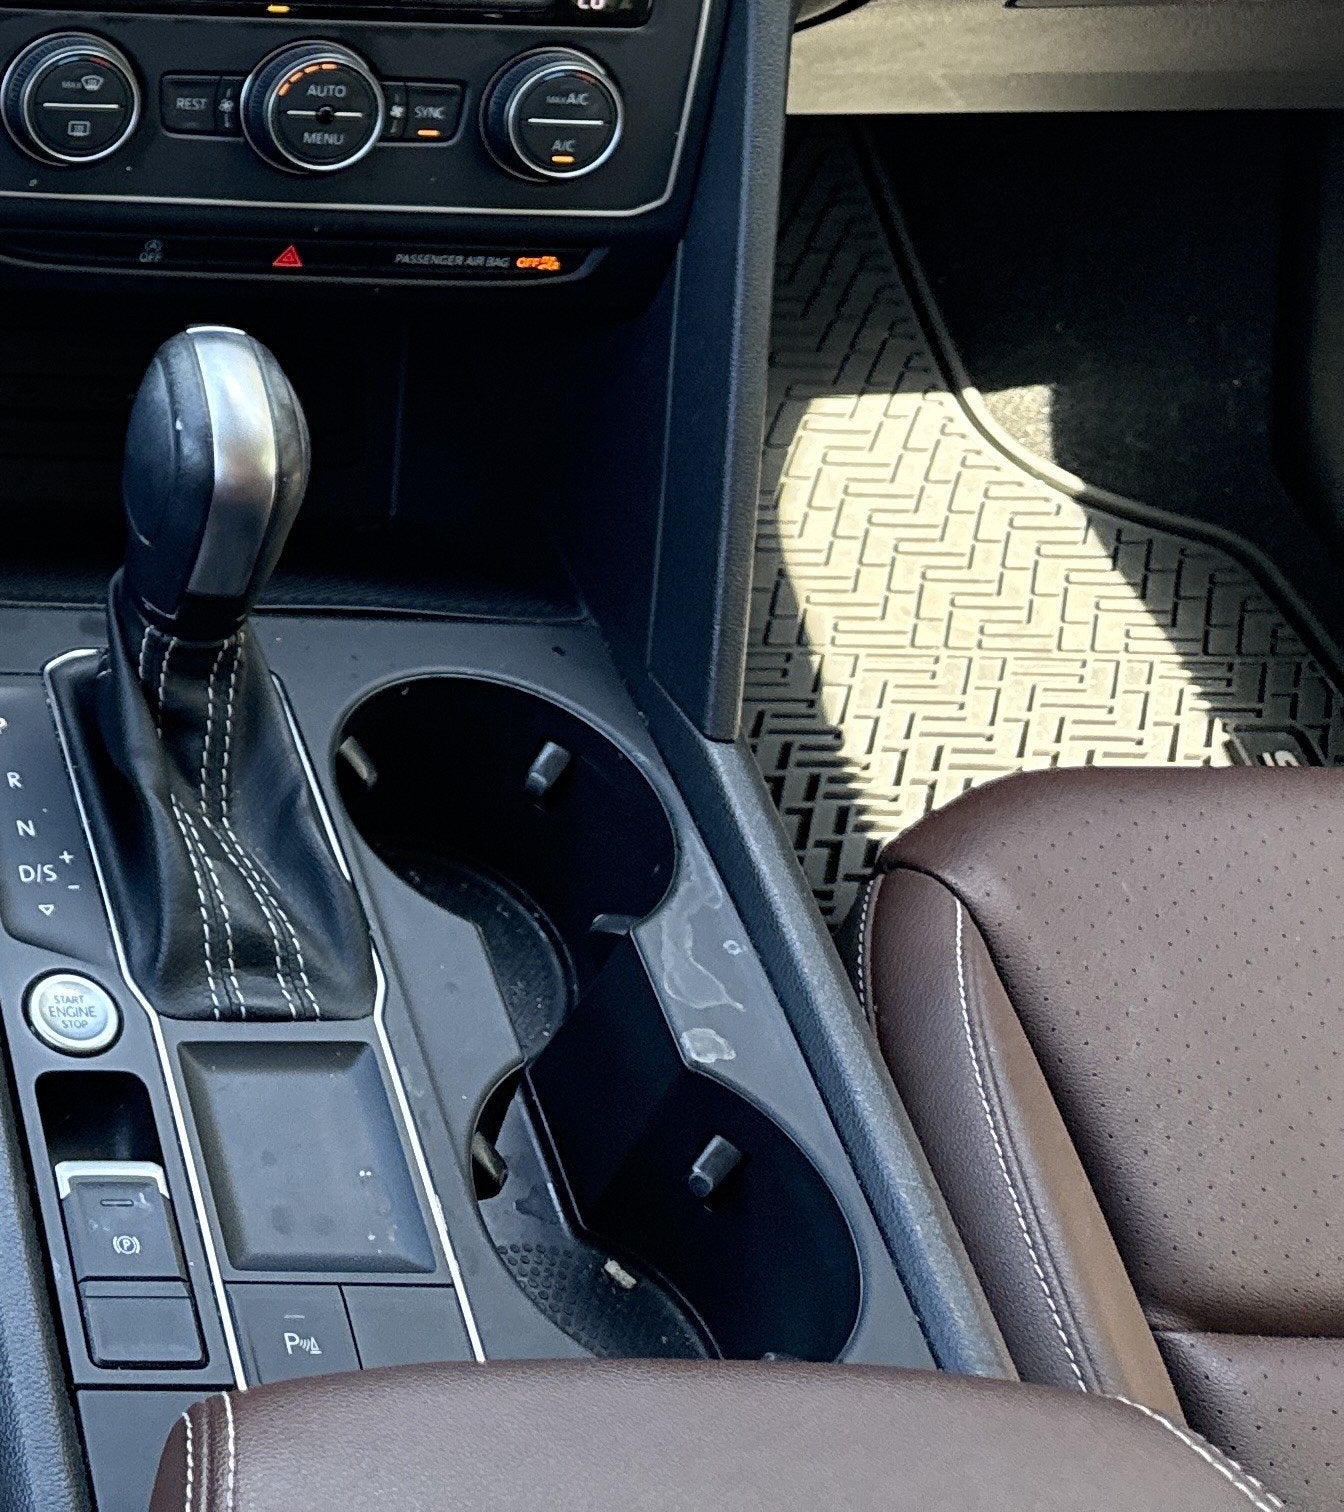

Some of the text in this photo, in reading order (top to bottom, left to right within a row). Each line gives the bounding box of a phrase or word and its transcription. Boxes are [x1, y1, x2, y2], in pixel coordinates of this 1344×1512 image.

[307, 84, 347, 98] AUTO
[176, 97, 207, 111] REST
[415, 106, 445, 120] SYNC
[303, 132, 345, 146] MENU
[551, 139, 577, 153] A/C
[394, 253, 463, 266] PASSENGER
[7, 772, 23, 788] R
[16, 820, 36, 837] N
[18, 863, 57, 883] D/S
[54, 995, 84, 1004] START
[48, 1005, 97, 1018] ENGINE
[62, 1019, 88, 1029] STOP
